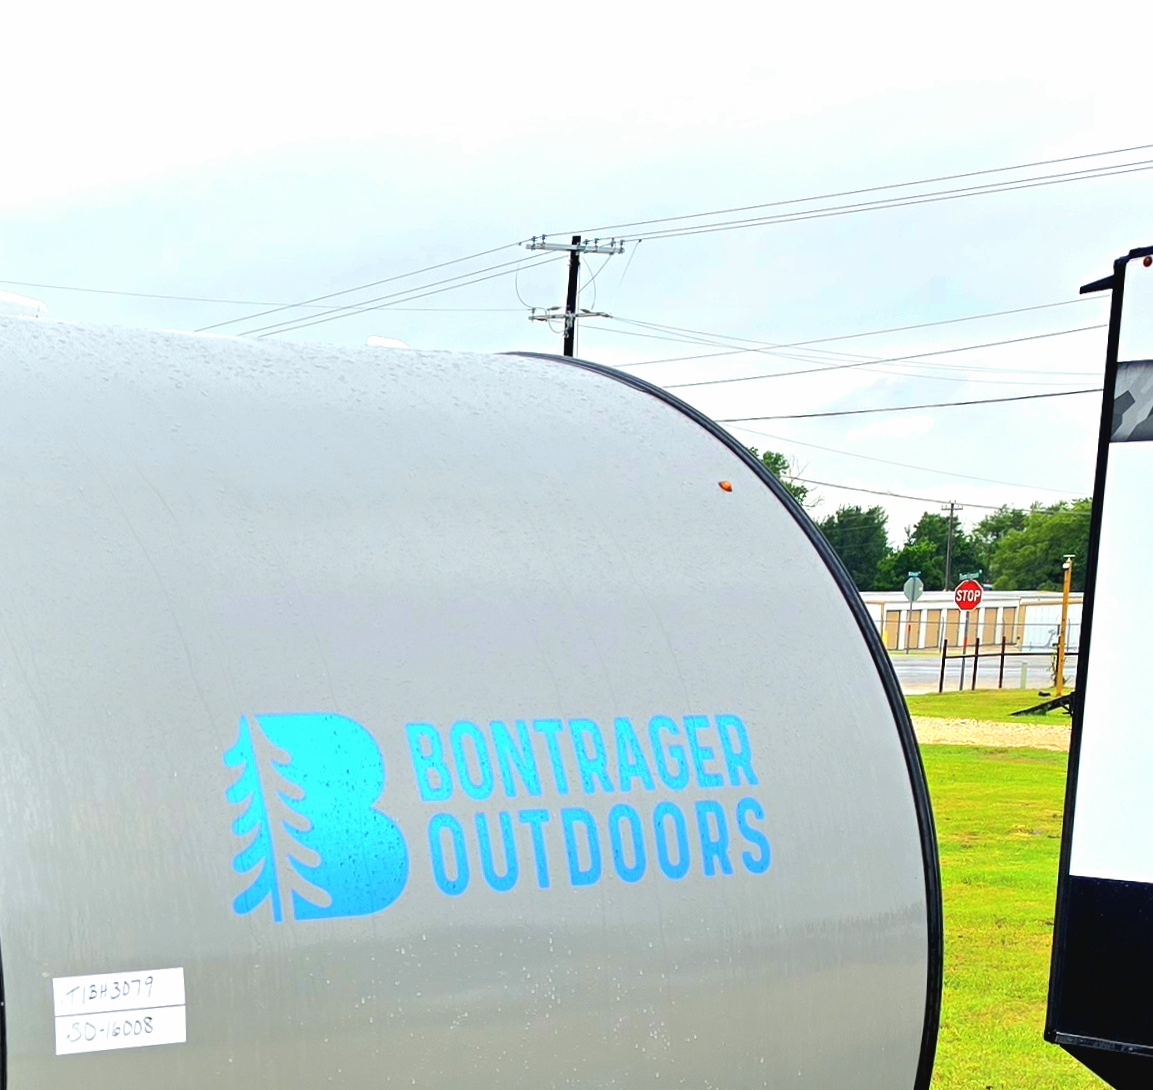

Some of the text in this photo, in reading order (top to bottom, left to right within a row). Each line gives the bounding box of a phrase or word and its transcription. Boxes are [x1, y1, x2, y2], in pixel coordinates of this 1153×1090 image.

[955, 590, 981, 602] STOP
[404, 713, 760, 803] BONTRAGER
[427, 796, 772, 898] OUTDOORS
